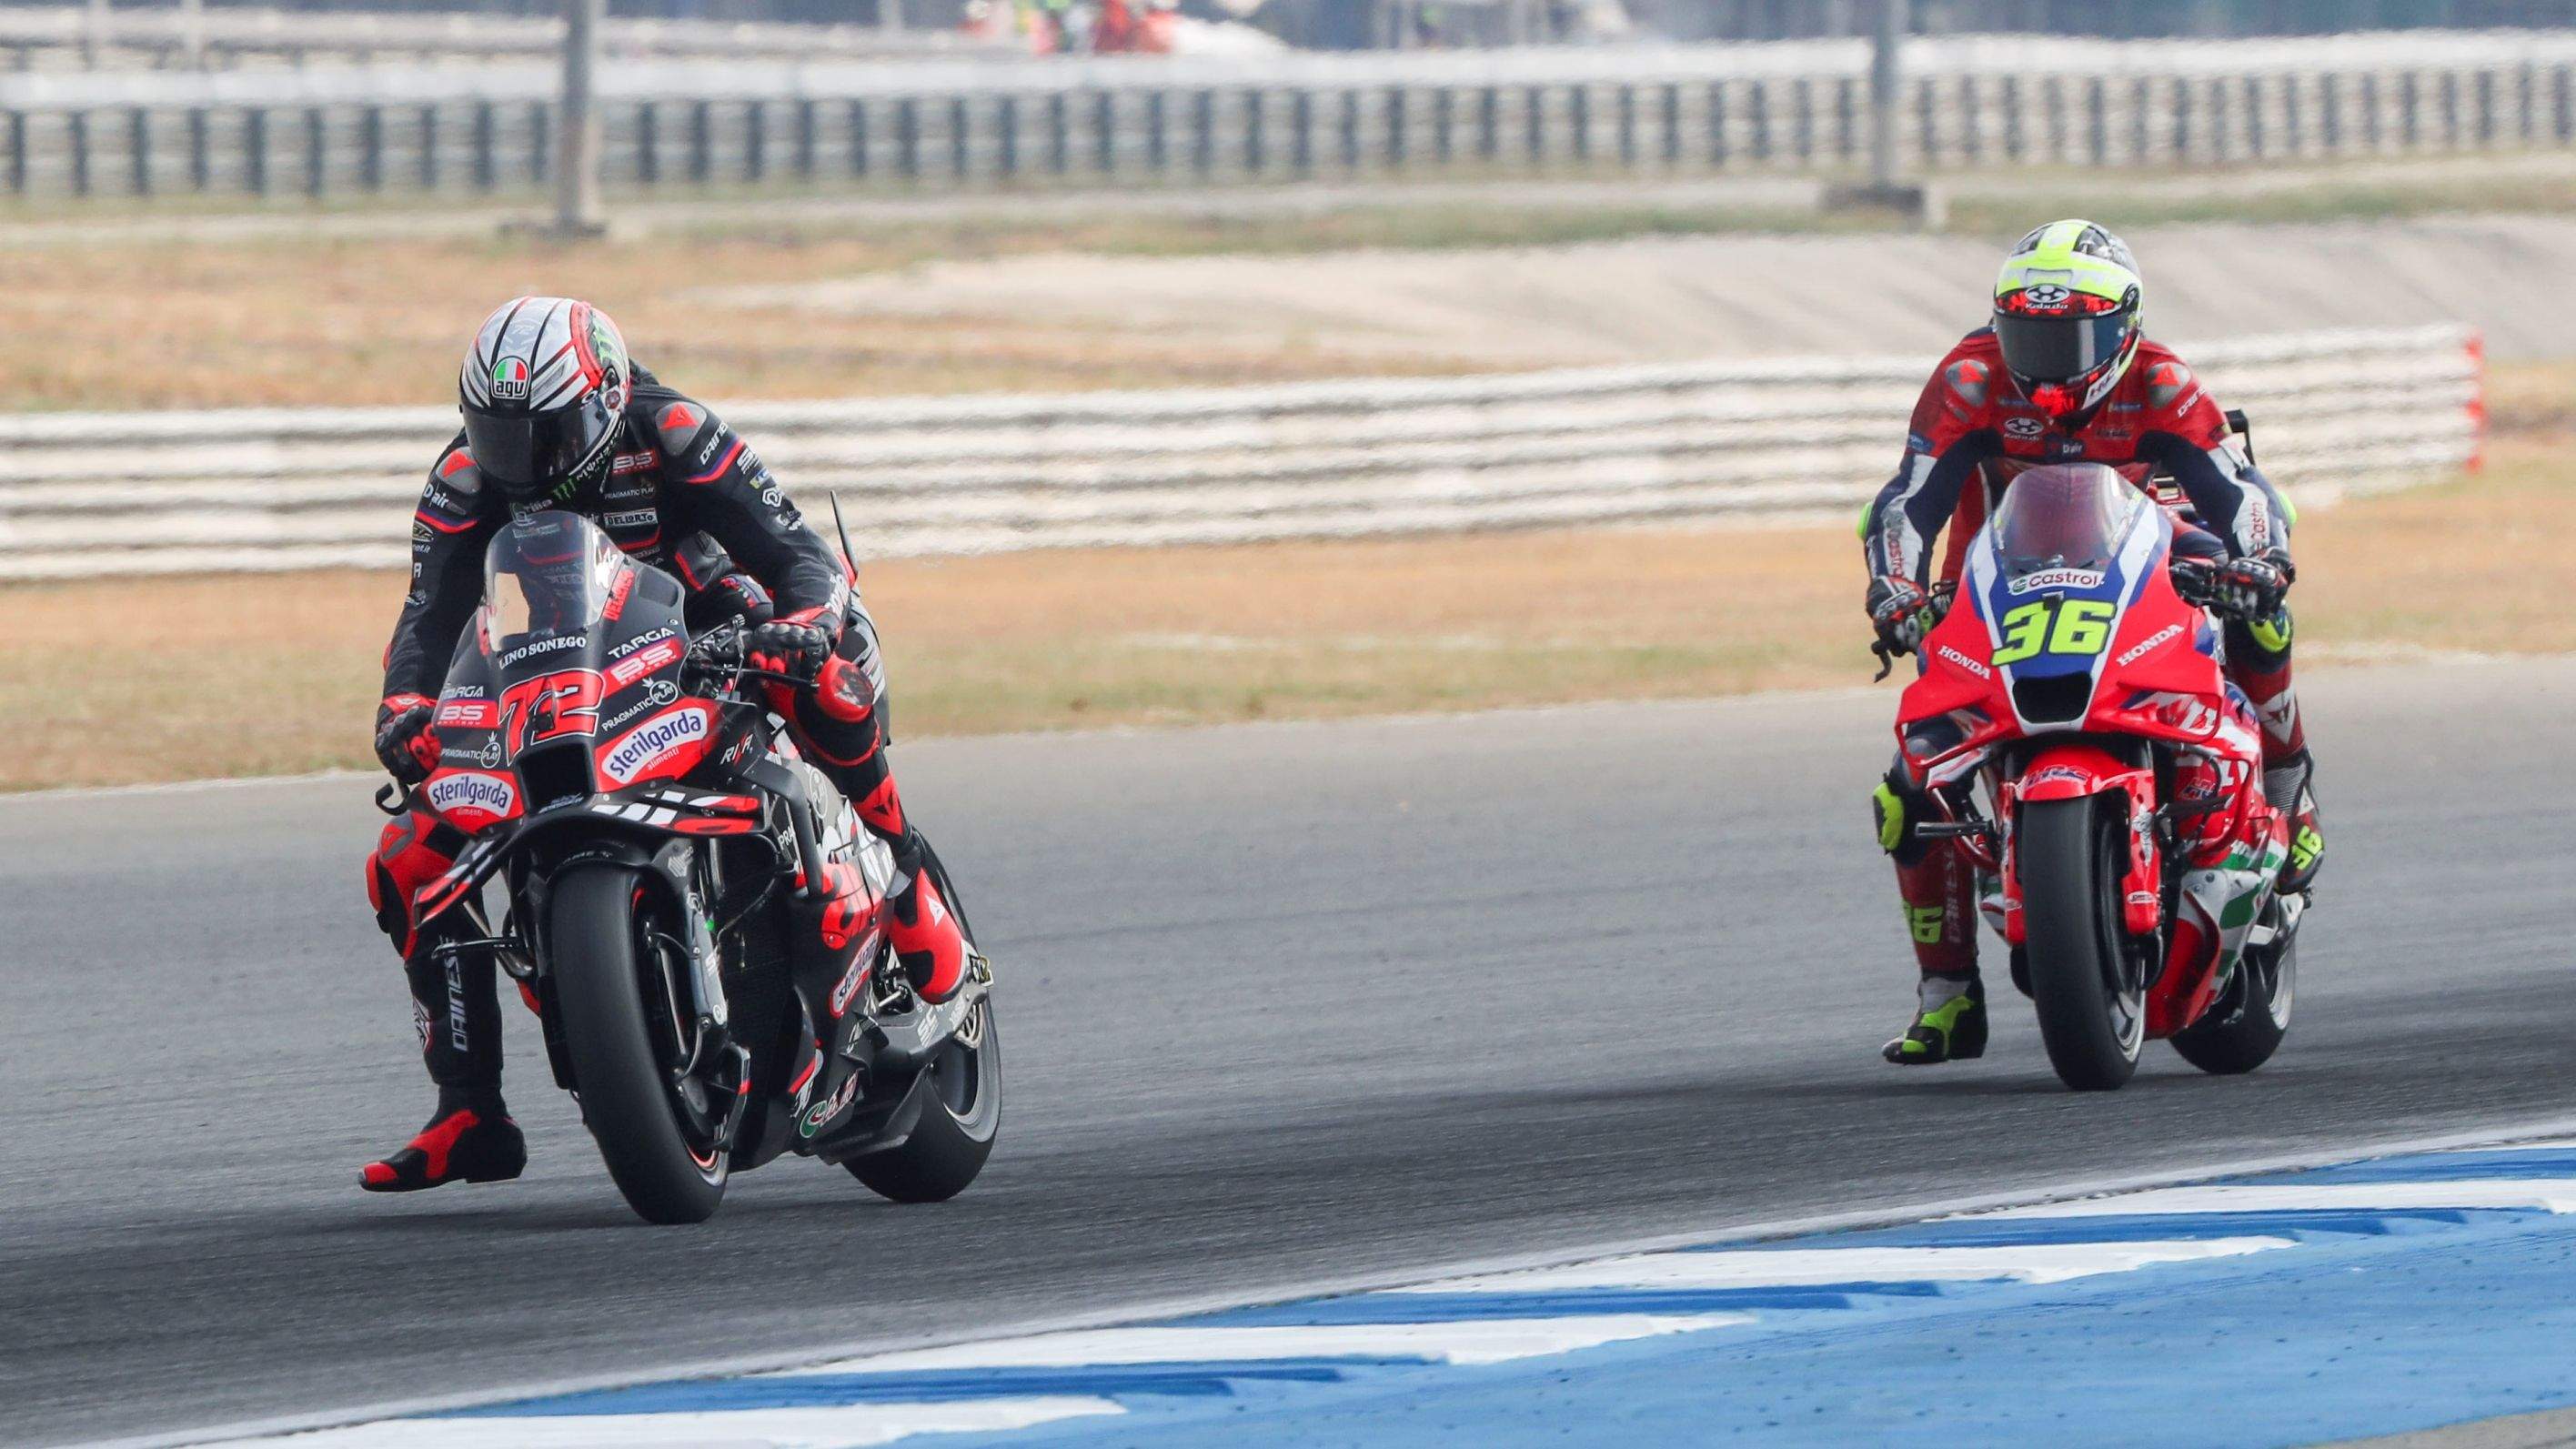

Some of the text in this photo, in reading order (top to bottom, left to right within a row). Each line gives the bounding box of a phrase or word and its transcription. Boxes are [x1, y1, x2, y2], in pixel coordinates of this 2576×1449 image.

[496, 380, 525, 397] agv
[612, 452, 653, 469] BS
[2028, 572, 2098, 588] Castrol
[608, 627, 675, 659] TARGA
[1991, 599, 2117, 666] 36
[2116, 624, 2185, 667] HONDA
[499, 636, 587, 669] LINO SONEGO
[610, 643, 673, 680] BS
[1937, 645, 1991, 679] HONDA
[438, 705, 488, 721] BS
[498, 668, 605, 767] 72
[600, 686, 675, 732] PRAGMATIC PLAY
[440, 748, 499, 760] PRAGMATIC PLAY
[609, 711, 701, 778] sterilgarda
[432, 777, 509, 805] sterilgarda
